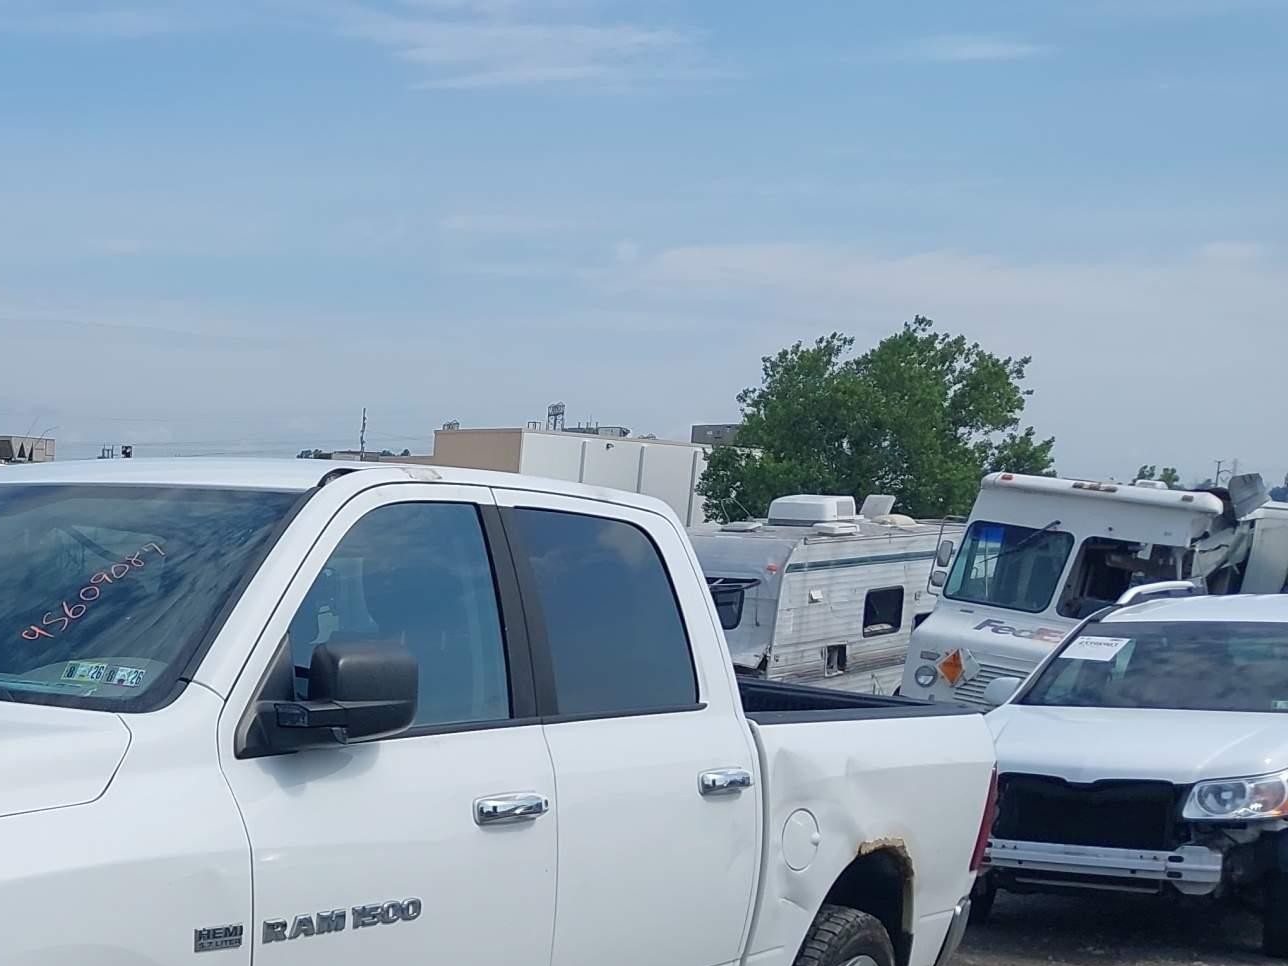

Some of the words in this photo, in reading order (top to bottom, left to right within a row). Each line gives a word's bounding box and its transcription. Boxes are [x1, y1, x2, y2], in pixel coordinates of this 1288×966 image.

[973, 618, 1066, 643] FedE
[262, 908, 346, 944] RAM
[351, 896, 423, 930] 1500
[198, 924, 244, 941] HEMI
[215, 938, 242, 947] LITER
